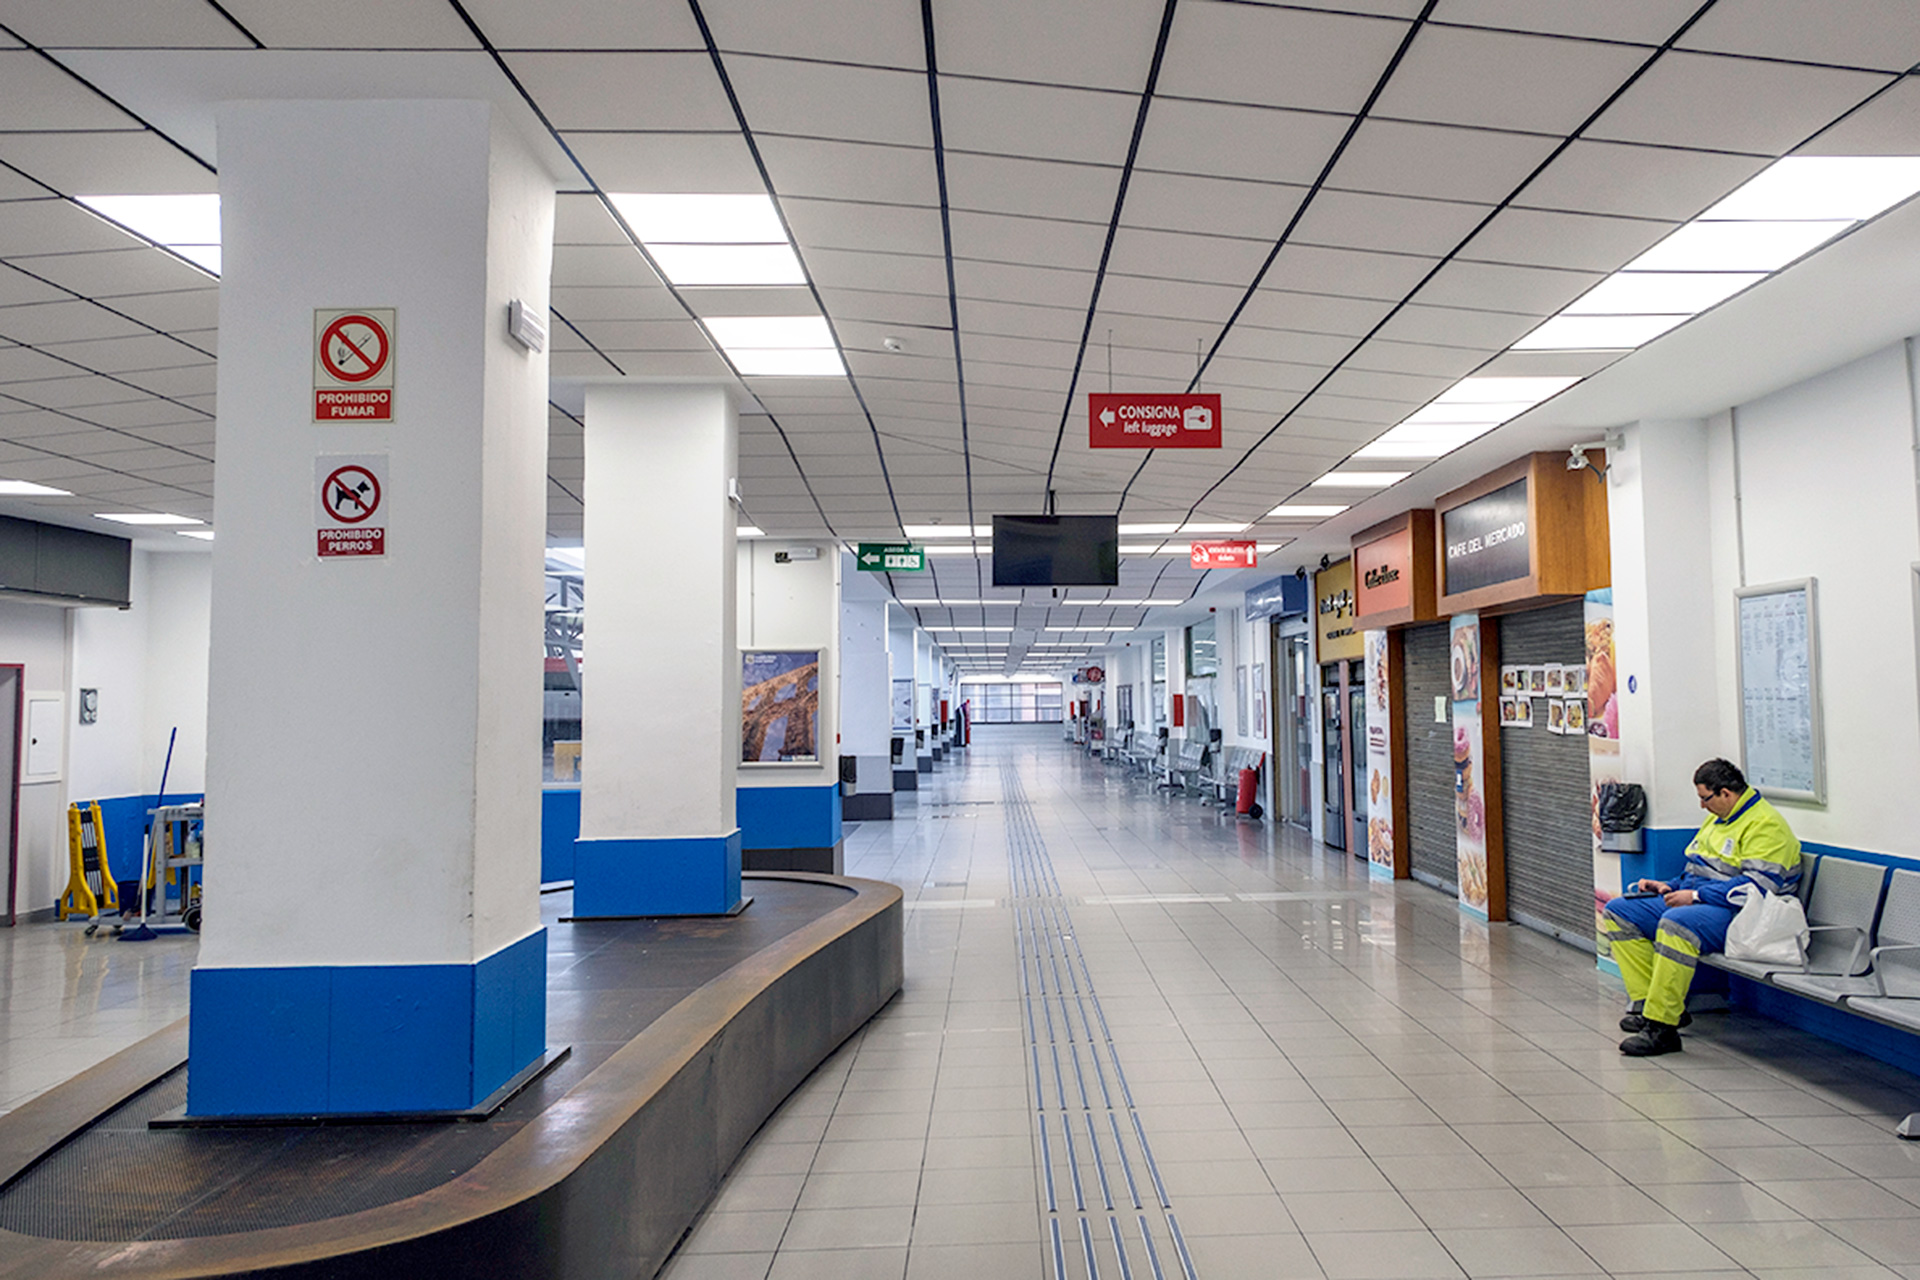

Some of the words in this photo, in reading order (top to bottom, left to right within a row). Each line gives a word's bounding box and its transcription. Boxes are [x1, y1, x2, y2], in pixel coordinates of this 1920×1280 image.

[319, 393, 388, 404] PROHIBIDO
[331, 405, 375, 417] FUMAR
[1118, 405, 1181, 419] CONSIGNA
[1124, 420, 1140, 433] left
[1142, 420, 1178, 437] luggage
[320, 529, 382, 540] PROHIBIDO
[1468, 537, 1483, 554] DEL
[1484, 521, 1525, 548] MERCADO
[328, 540, 374, 551] PERROS
